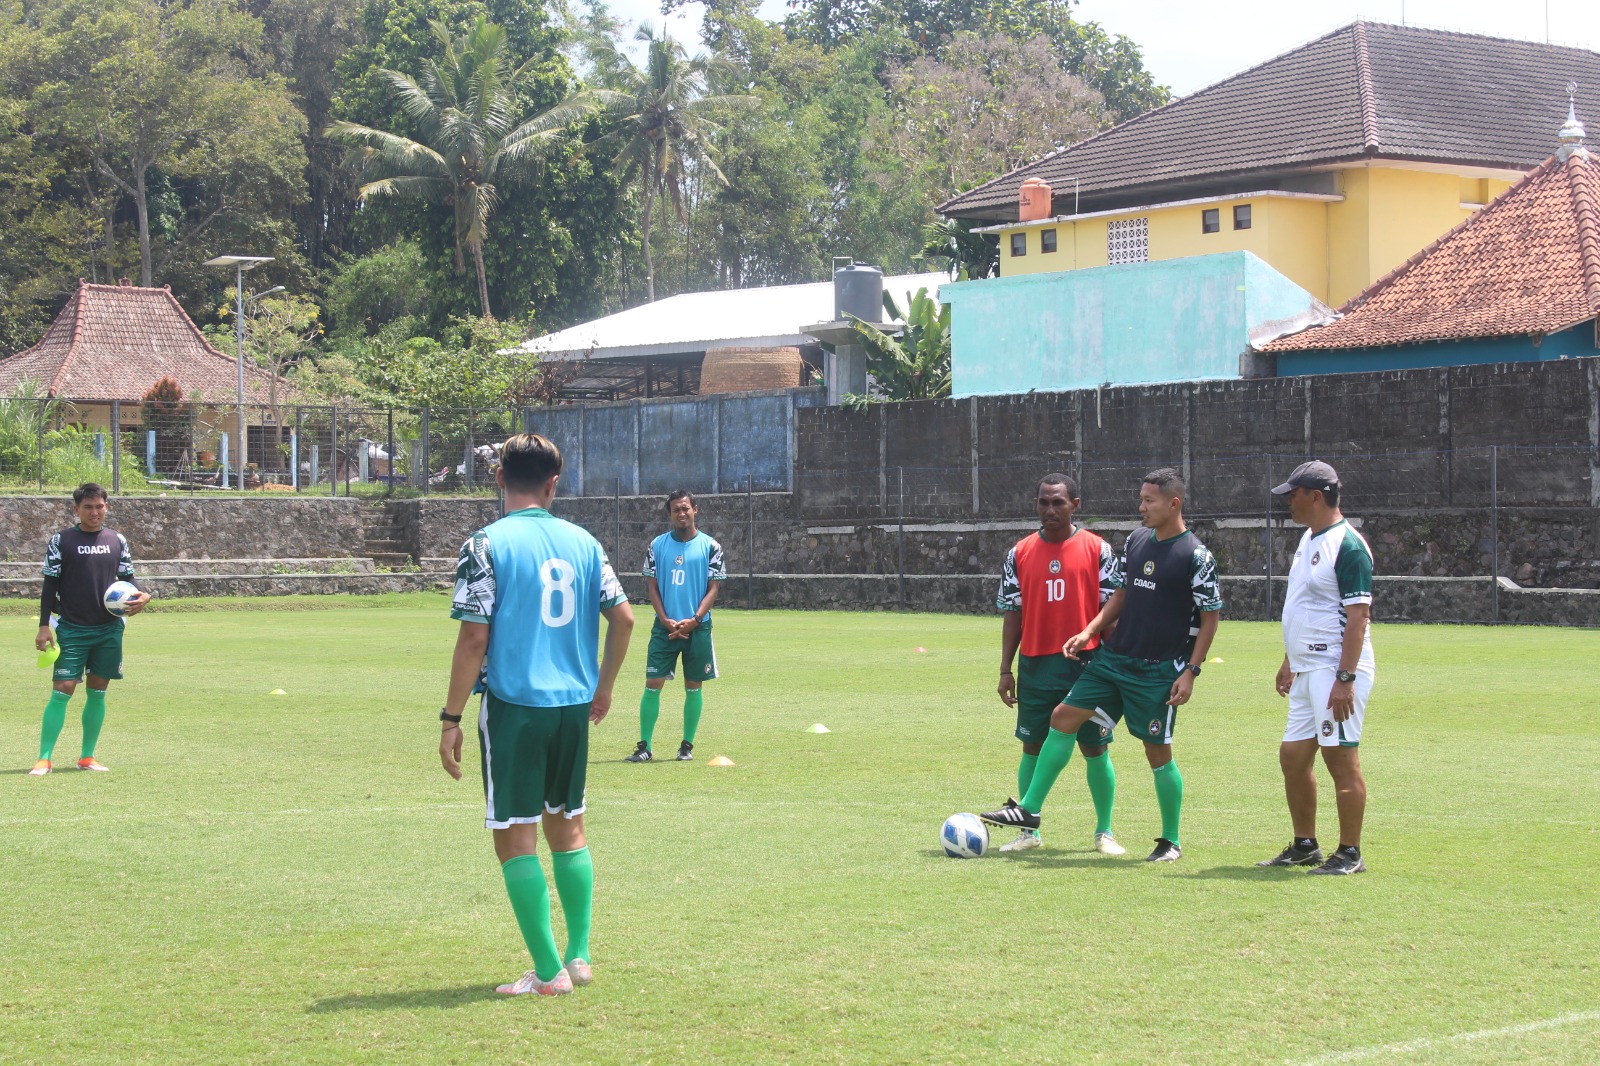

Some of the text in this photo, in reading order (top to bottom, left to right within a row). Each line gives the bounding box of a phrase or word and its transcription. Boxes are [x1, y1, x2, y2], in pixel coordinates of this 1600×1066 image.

[78, 544, 111, 556] COACH
[671, 569, 685, 586] 10
[1133, 577, 1156, 591] COACH
[540, 557, 575, 628] 8
[1045, 578, 1065, 602] 10
[454, 602, 479, 612] DIPLOMA
